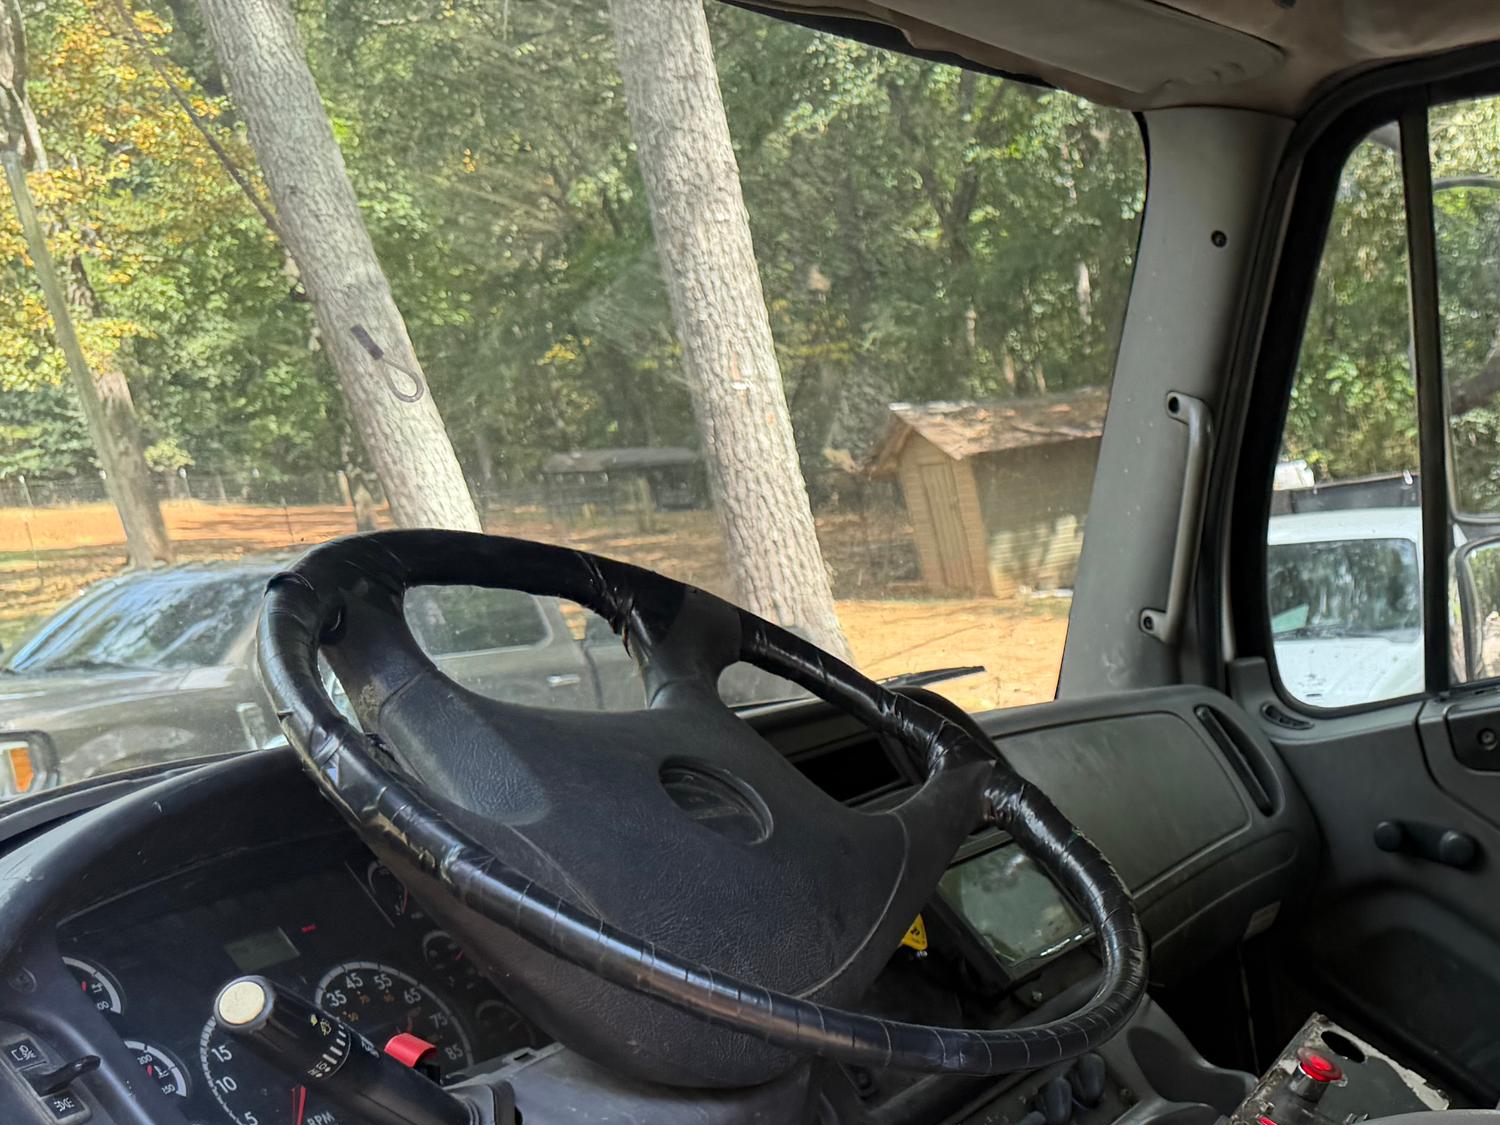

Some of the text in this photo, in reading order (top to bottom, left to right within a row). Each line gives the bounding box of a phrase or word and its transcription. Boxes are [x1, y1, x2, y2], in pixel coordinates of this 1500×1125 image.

[346, 972, 364, 990] 45
[373, 973, 392, 991] 55
[326, 989, 348, 1007] 35
[404, 987, 422, 1005] 65
[211, 1044, 233, 1063] 15
[444, 1043, 464, 1061] 85
[214, 1076, 237, 1094] 10
